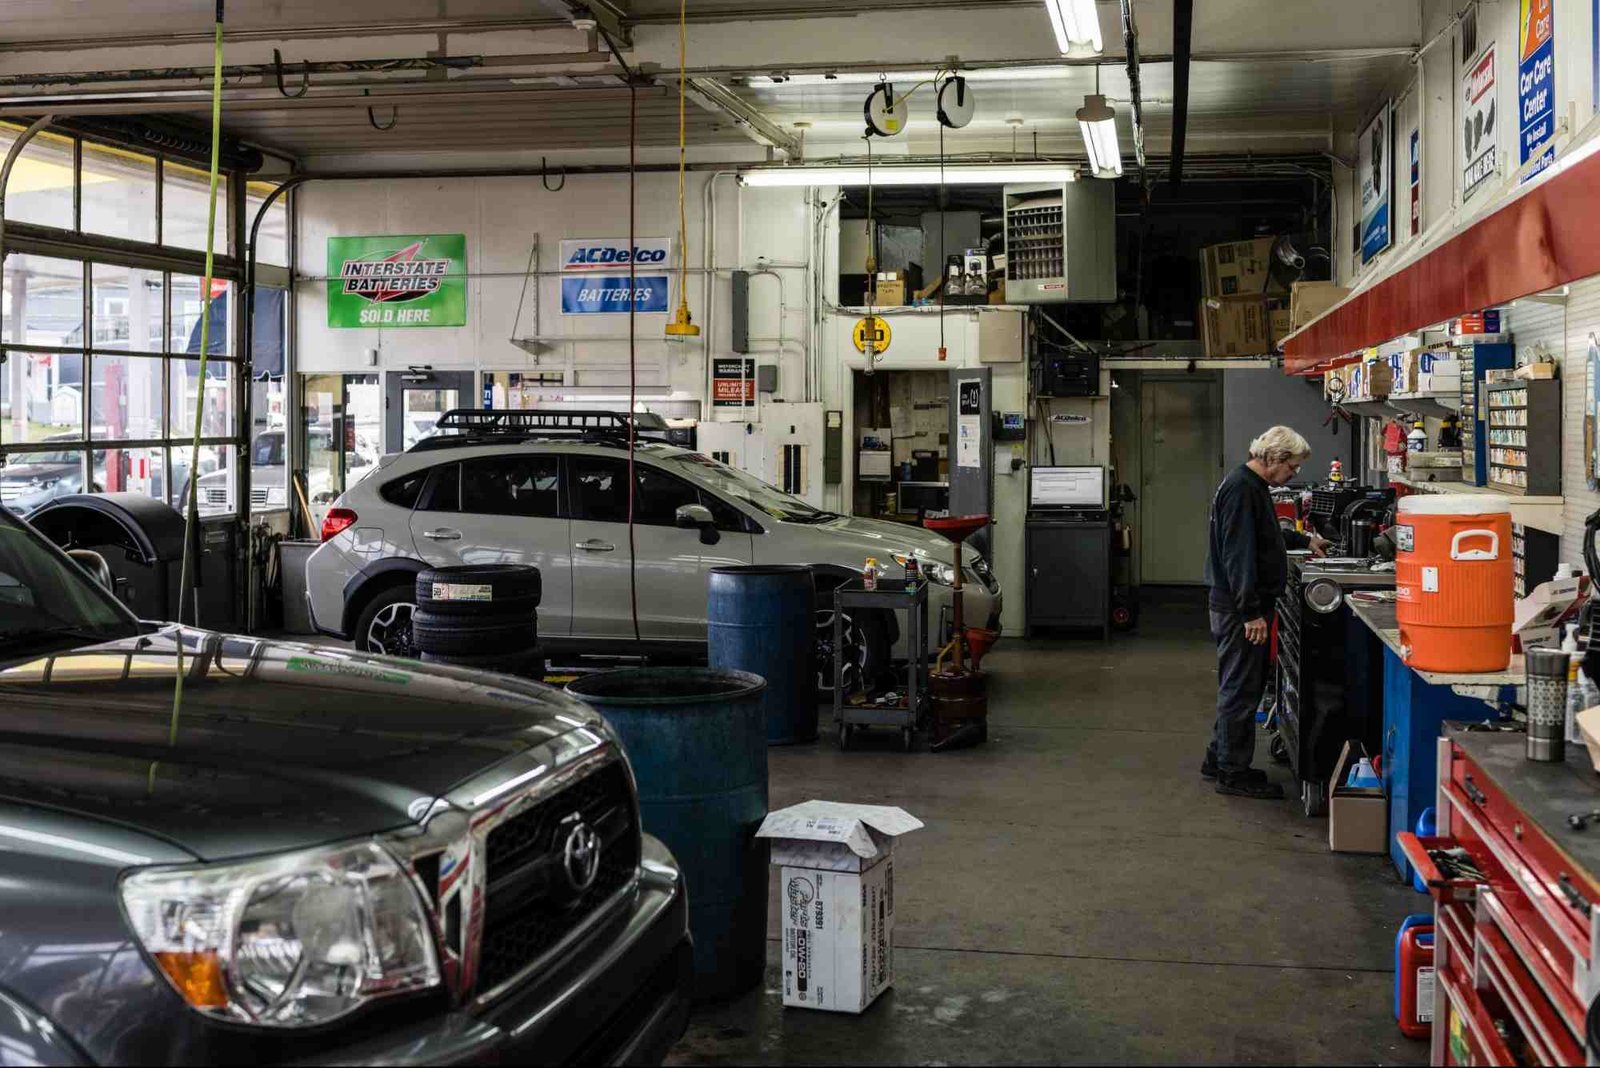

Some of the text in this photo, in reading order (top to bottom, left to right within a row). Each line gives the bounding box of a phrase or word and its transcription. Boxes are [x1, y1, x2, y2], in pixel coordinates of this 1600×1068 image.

[1521, 55, 1551, 97] Car Care
[1524, 88, 1547, 122] Center
[568, 247, 666, 263] ACDelco
[344, 260, 446, 276] INTERSTATE
[346, 277, 439, 291] BATTERIES
[360, 308, 431, 323] SOLD HERE
[815, 900, 824, 930] 879391
